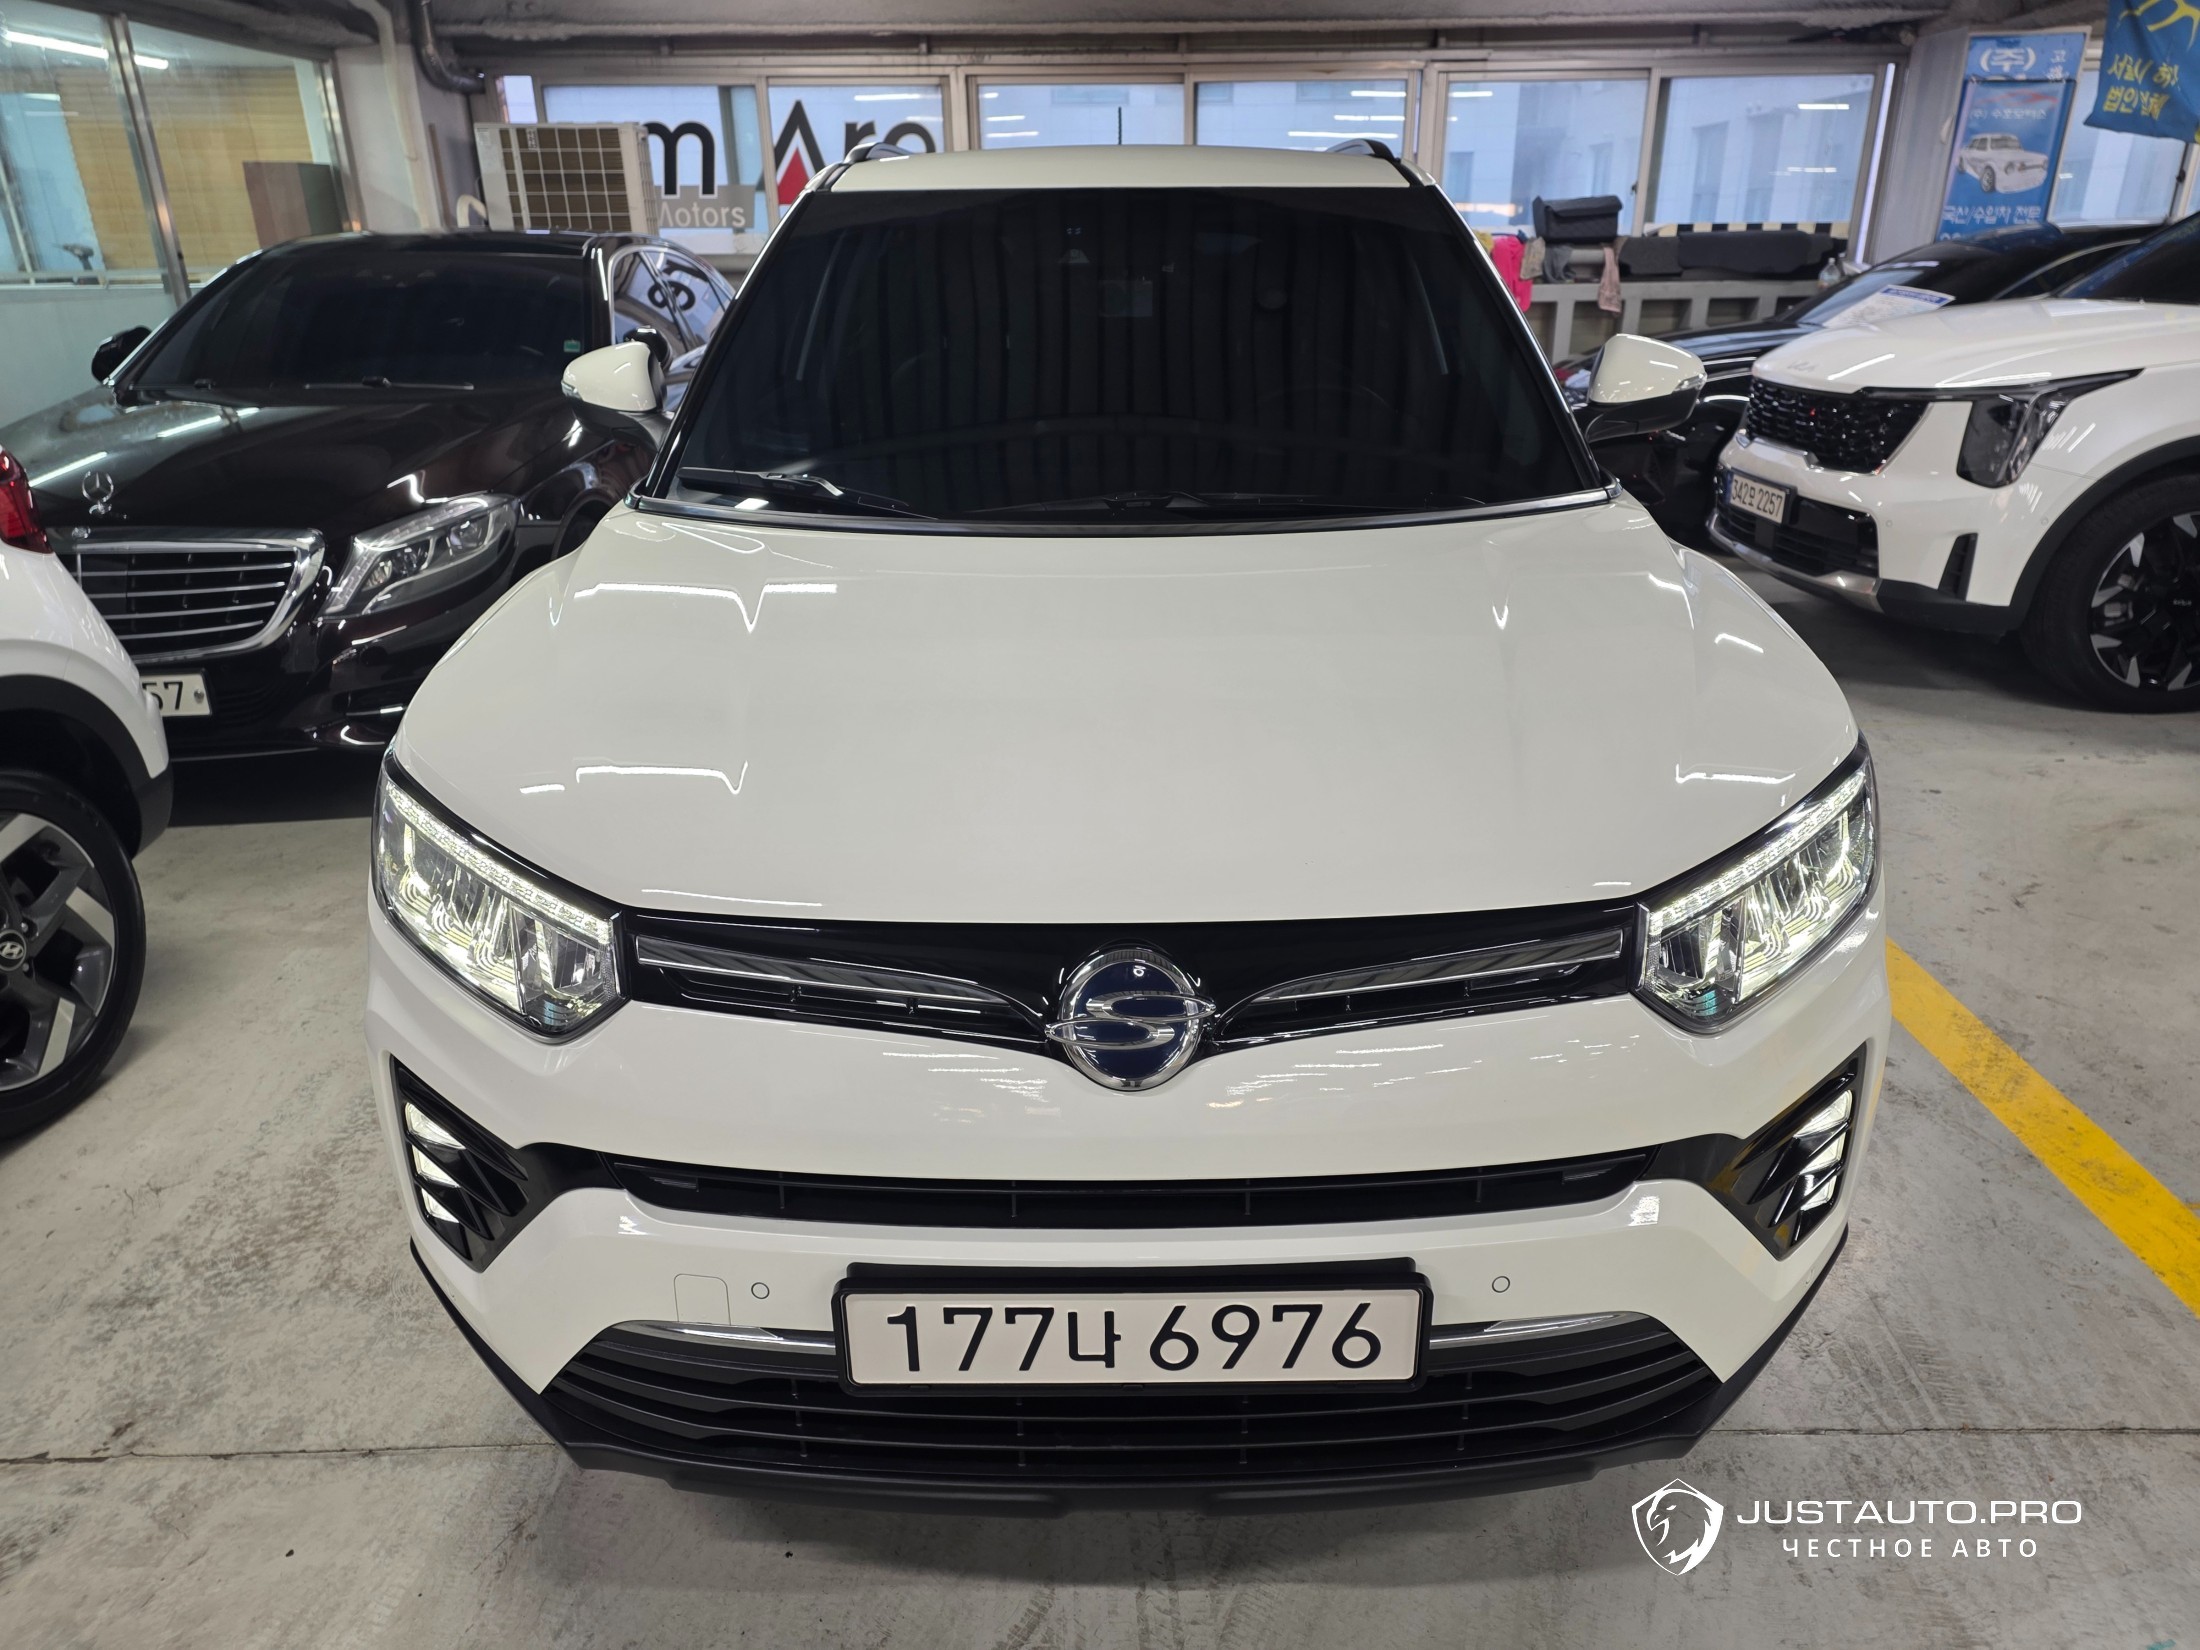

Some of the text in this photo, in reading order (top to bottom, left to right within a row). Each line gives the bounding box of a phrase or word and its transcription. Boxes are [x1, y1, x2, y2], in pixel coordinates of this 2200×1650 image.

[1979, 47, 2036, 72] (주)
[2012, 204, 2042, 224] 전문
[1756, 488, 1784, 518] 2257
[887, 1303, 1381, 1371] 177나 6976
